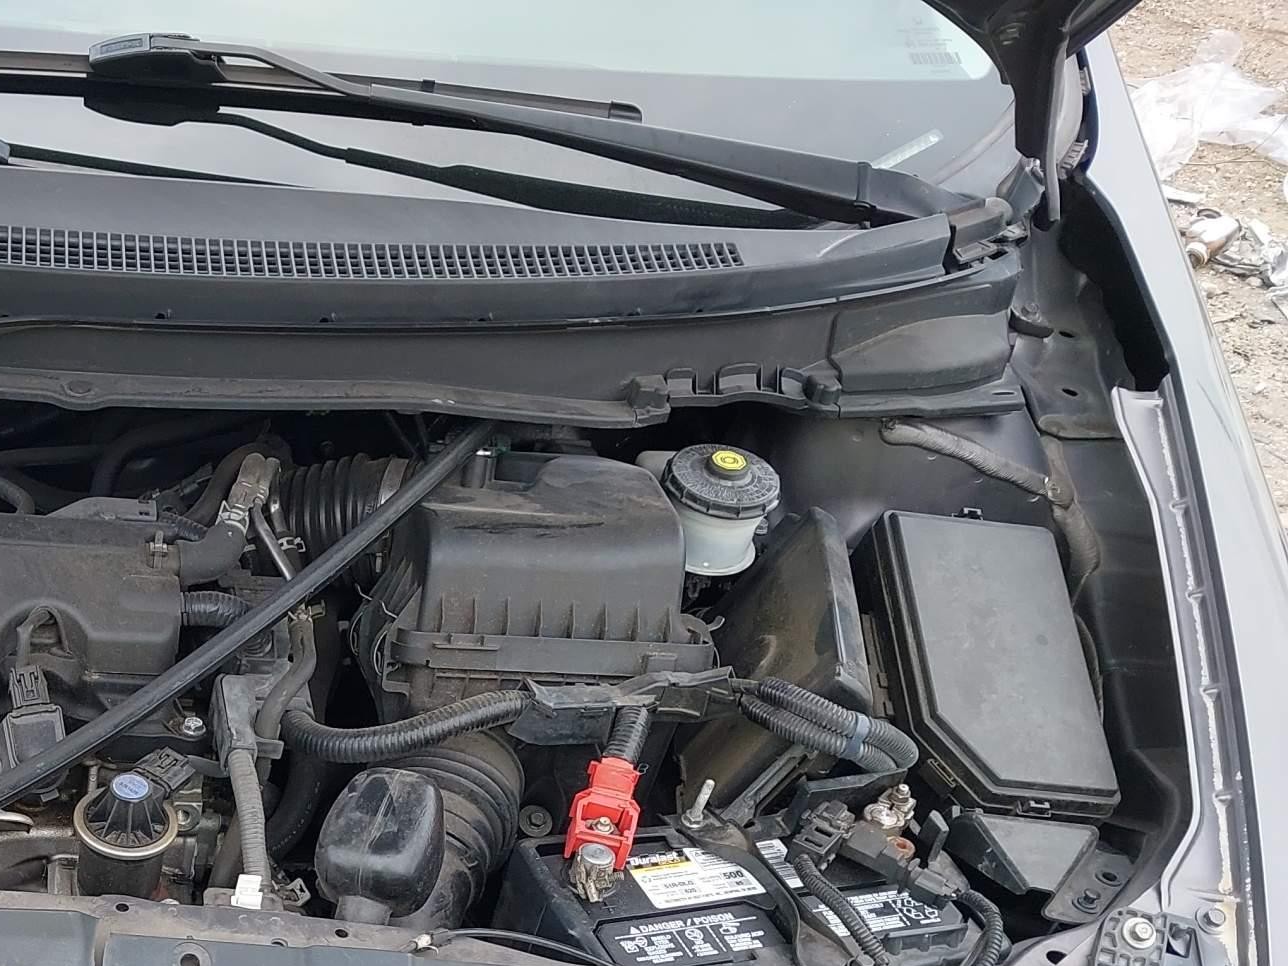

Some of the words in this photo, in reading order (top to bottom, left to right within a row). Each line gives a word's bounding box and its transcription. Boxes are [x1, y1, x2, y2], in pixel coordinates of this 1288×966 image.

[628, 851, 681, 866] Duralast
[723, 870, 745, 880] 500
[639, 919, 686, 933] DANGER
[693, 912, 735, 925] POISON
